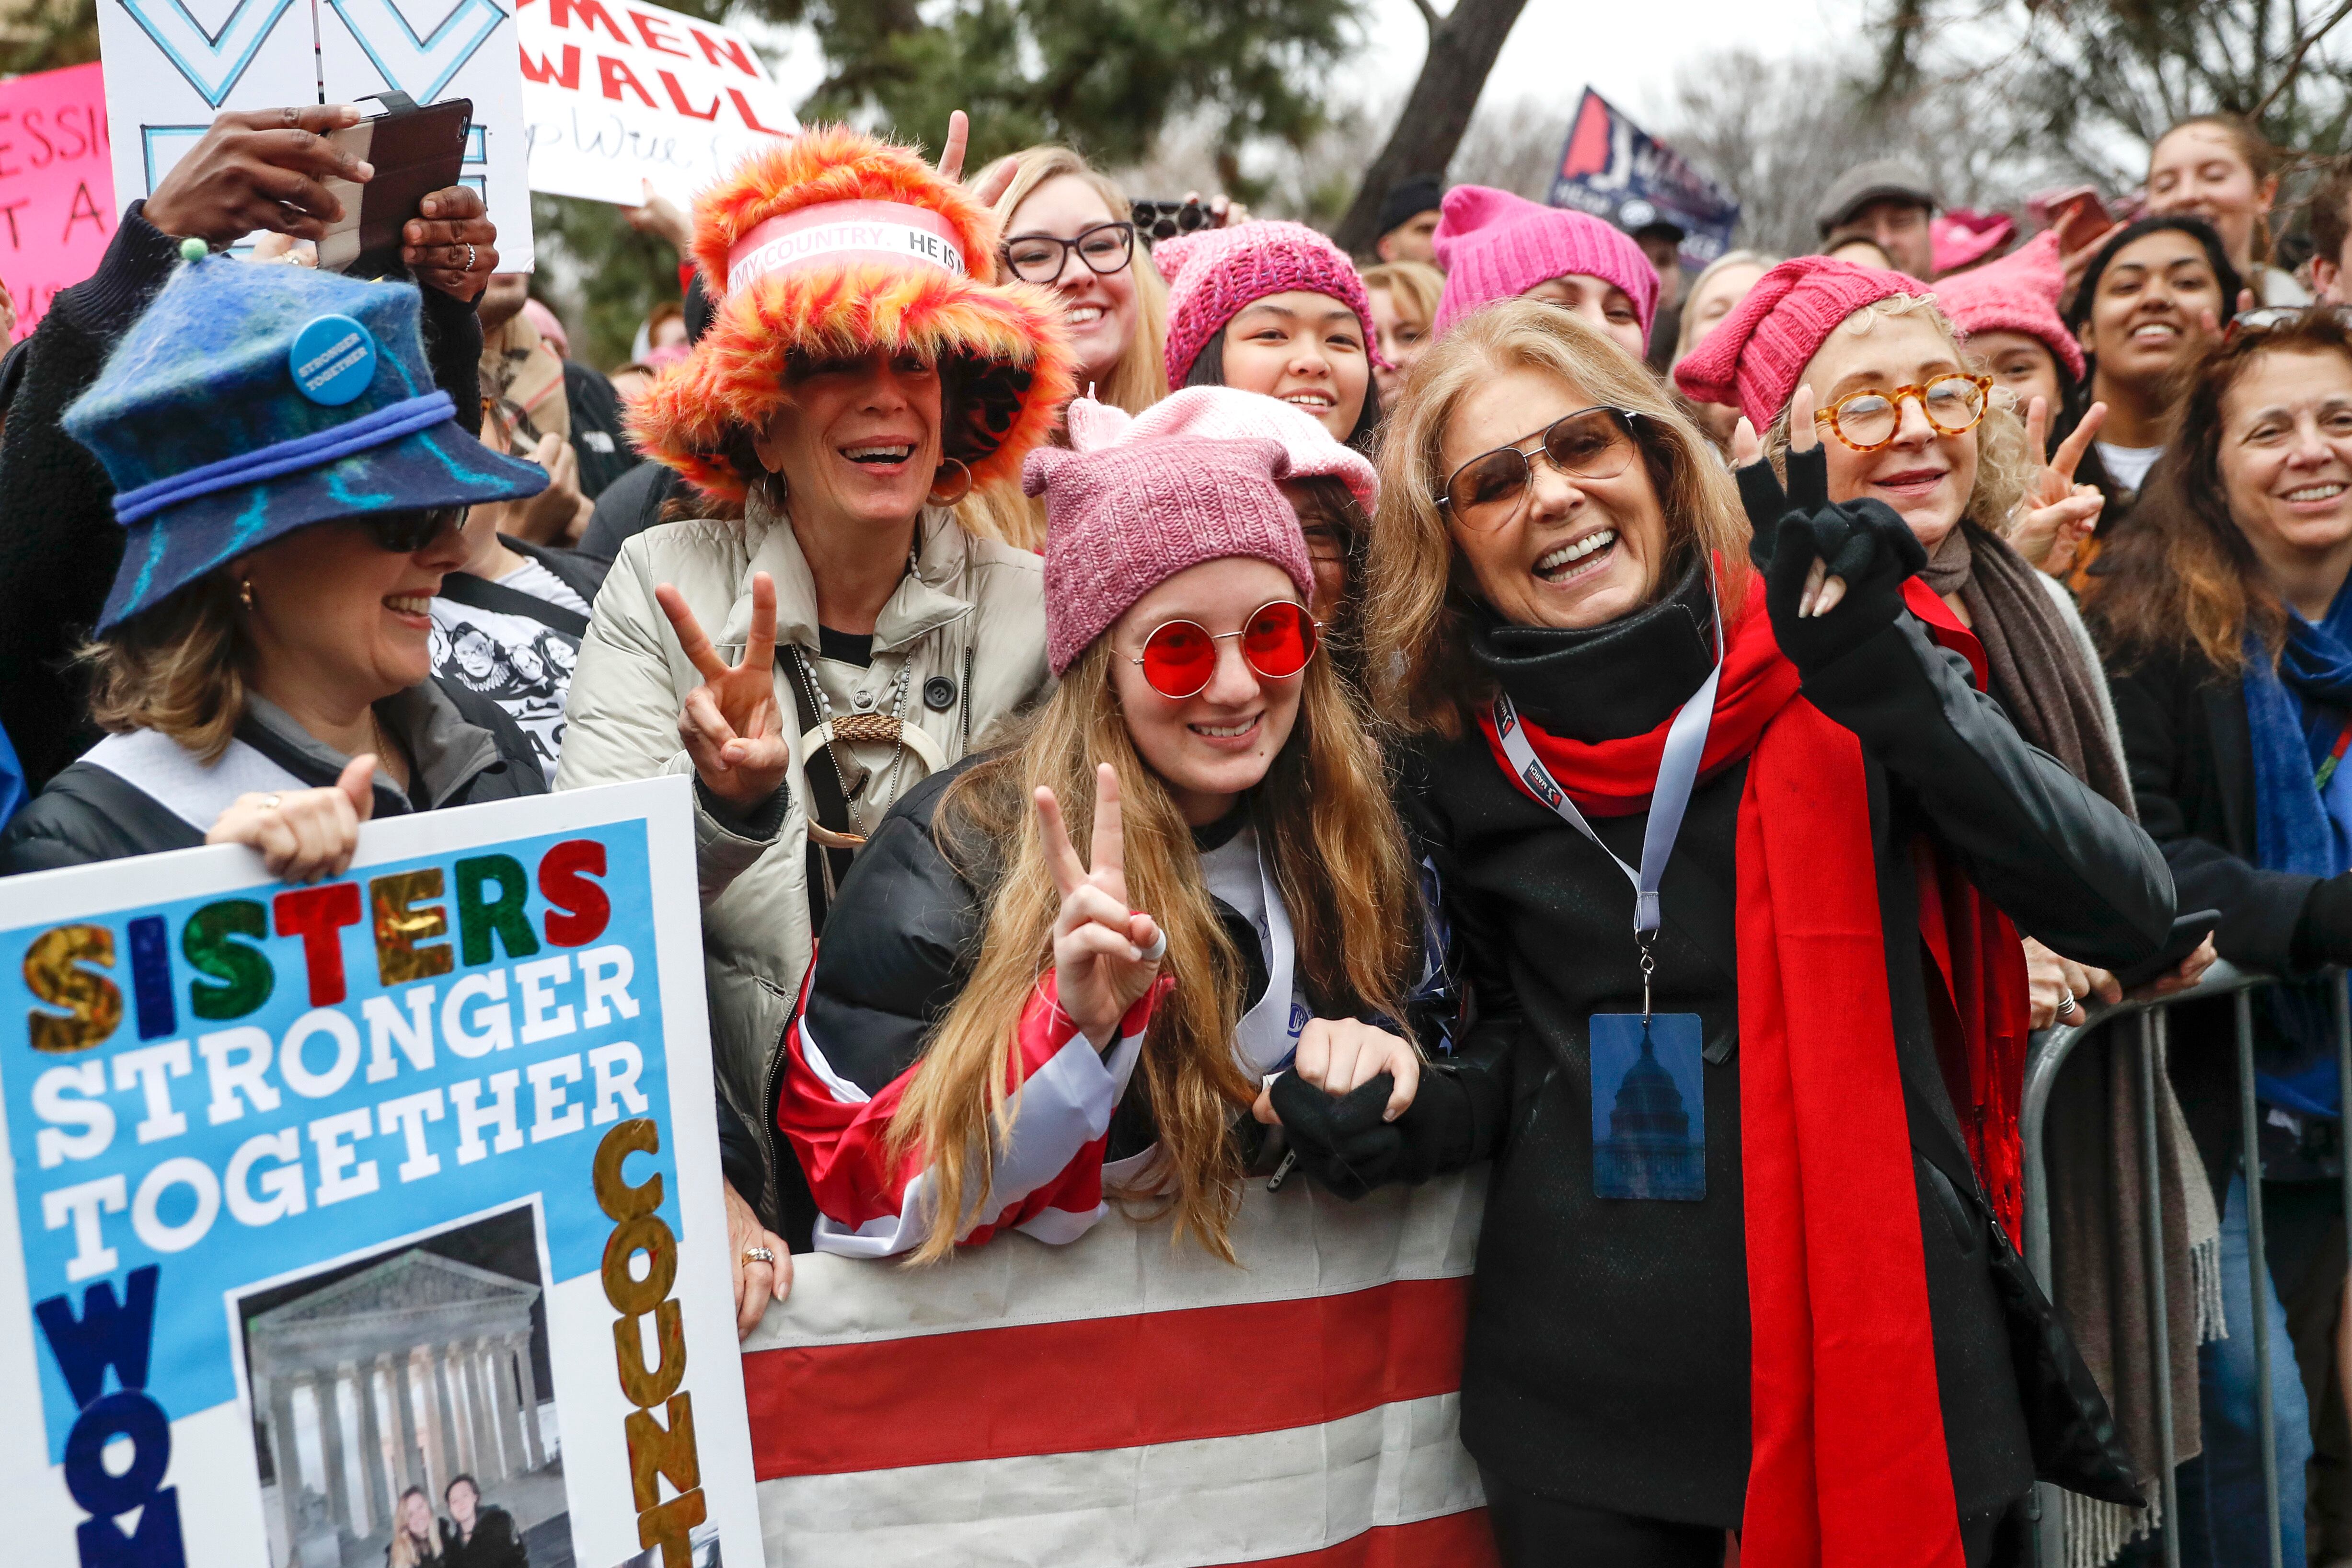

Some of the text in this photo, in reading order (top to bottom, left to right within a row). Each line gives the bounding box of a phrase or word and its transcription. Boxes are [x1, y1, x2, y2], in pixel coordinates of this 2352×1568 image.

[516, 0, 760, 78] MEN
[519, 42, 796, 139] WALL
[63, 181, 105, 242] A
[735, 253, 759, 290] MY
[765, 227, 890, 267] COUNTRY.
[910, 231, 937, 258] HE
[944, 245, 955, 270] IS
[298, 333, 362, 378] STRONGER
[305, 346, 369, 392] TOGETHER
[1529, 764, 1548, 790] MARCH
[23, 839, 611, 1054] SISTERS
[31, 945, 640, 1169] STRONGER
[42, 1041, 649, 1283] TOGETHER
[593, 1118, 707, 1568] COUNT
